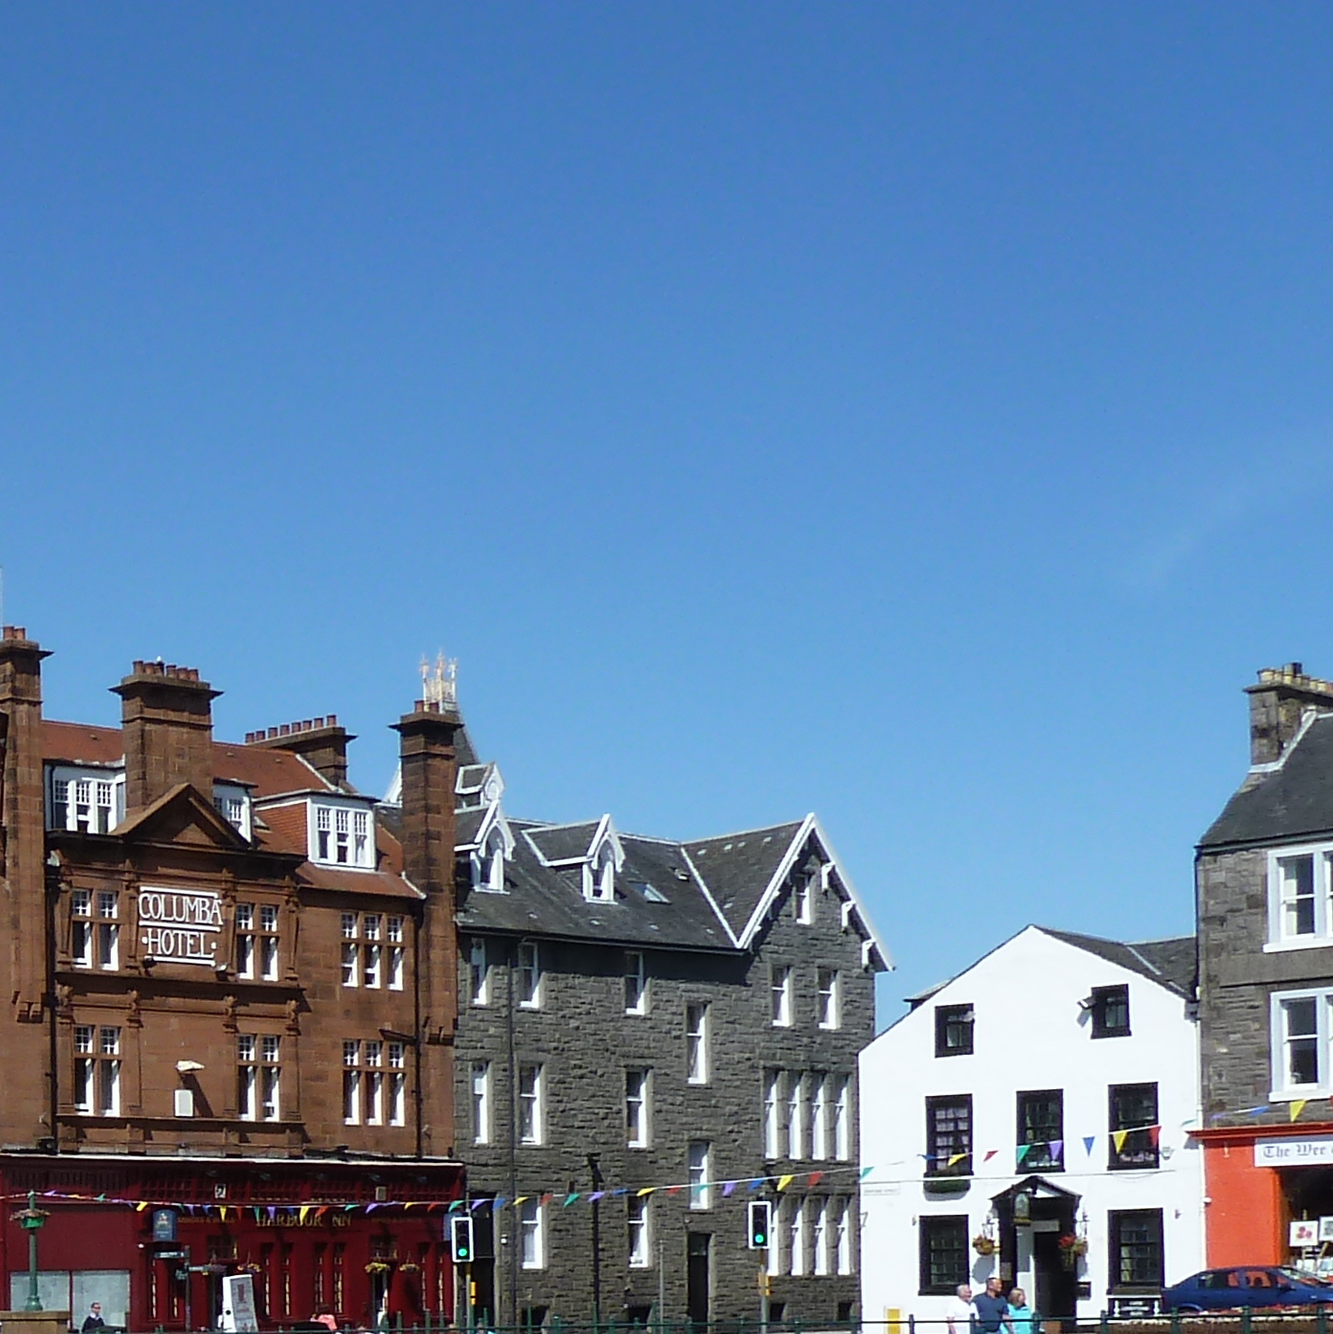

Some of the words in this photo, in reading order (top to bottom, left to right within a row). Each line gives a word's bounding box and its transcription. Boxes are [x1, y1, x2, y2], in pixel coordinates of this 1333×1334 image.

[139, 893, 223, 925] COLUMBA
[147, 928, 214, 958] HOTEL
[1263, 1146, 1290, 1158] The
[1296, 1144, 1326, 1156] Wee
[255, 1213, 322, 1228] HARBOUR
